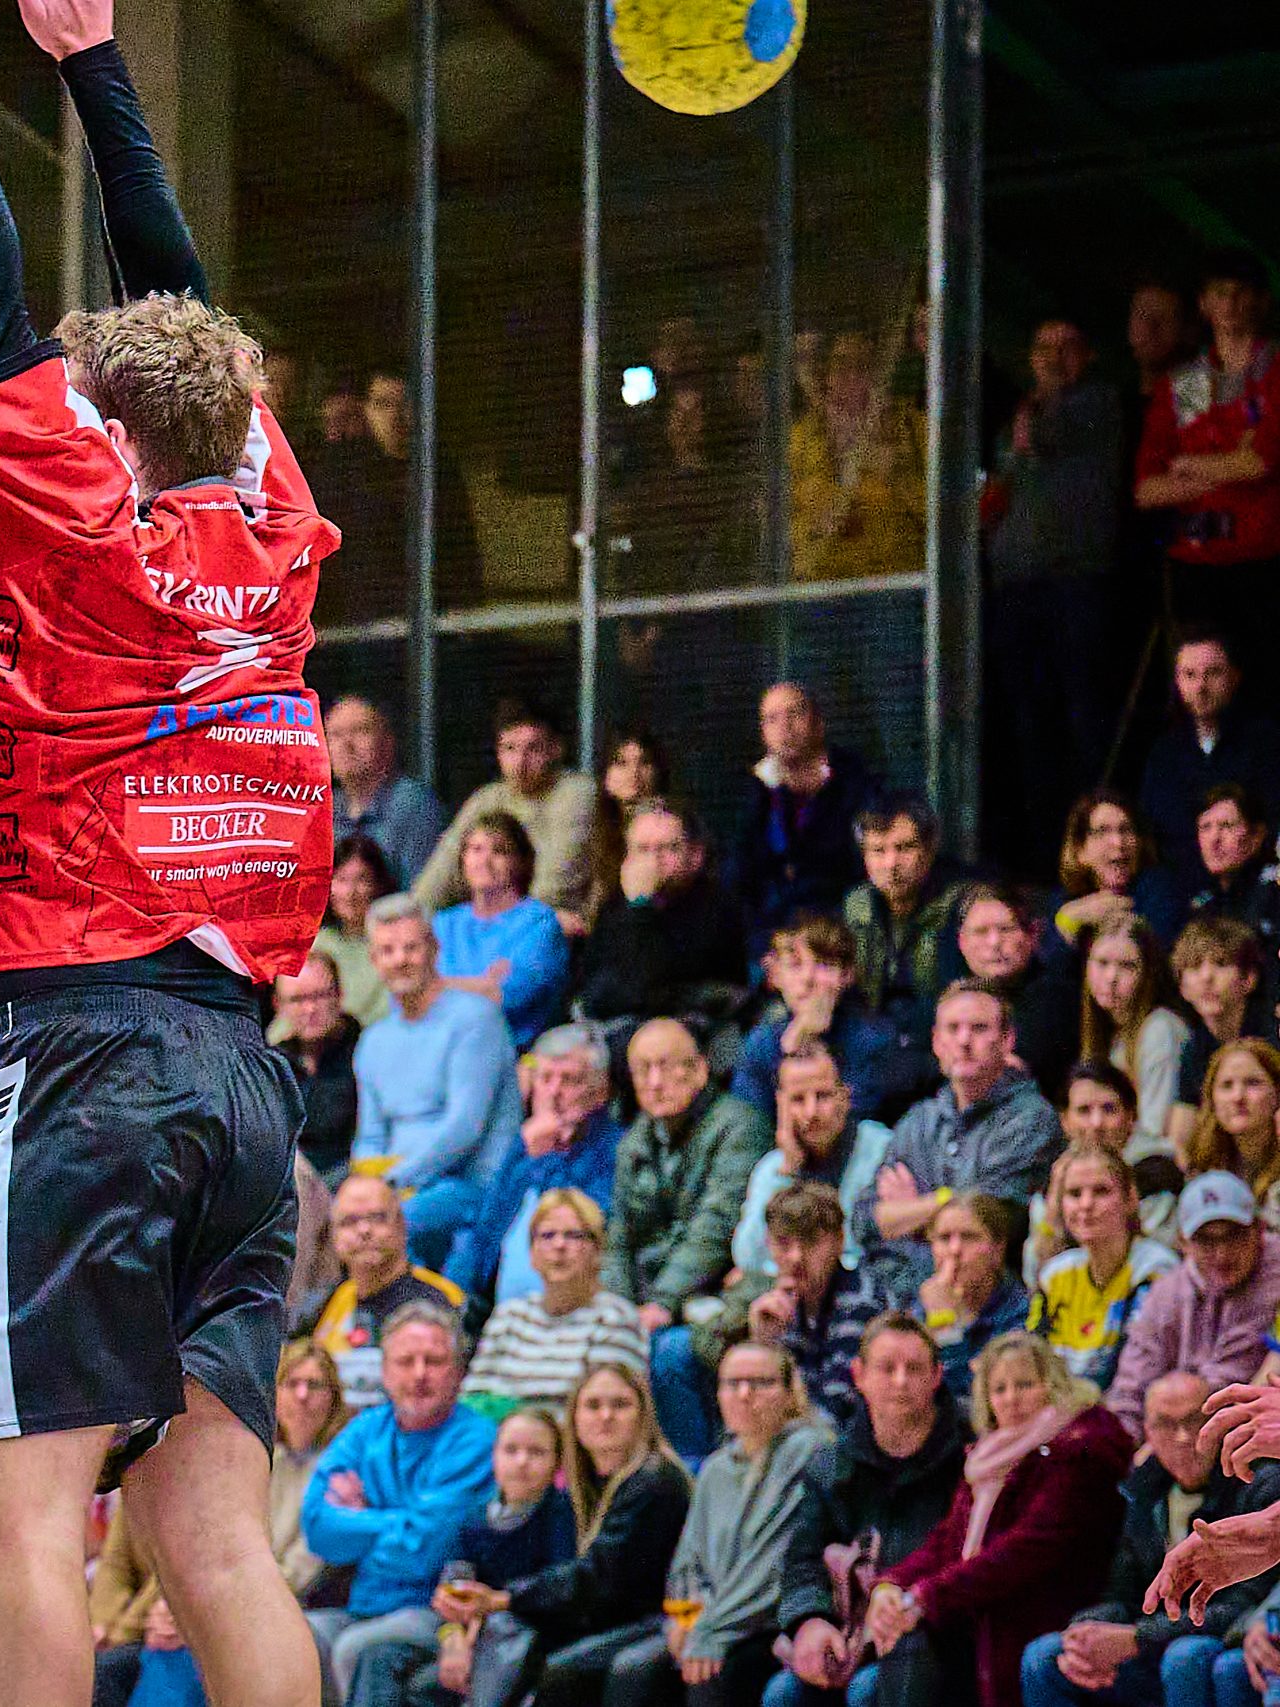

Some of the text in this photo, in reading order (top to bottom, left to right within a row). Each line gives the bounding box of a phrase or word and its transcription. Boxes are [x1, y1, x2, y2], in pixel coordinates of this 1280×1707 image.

[124, 774, 327, 802] ELEKTROTECHNIK
[169, 811, 267, 843] BECKER
[166, 864, 205, 882] smart
[206, 863, 232, 881] way
[231, 860, 243, 874] to
[244, 860, 299, 878] energy
